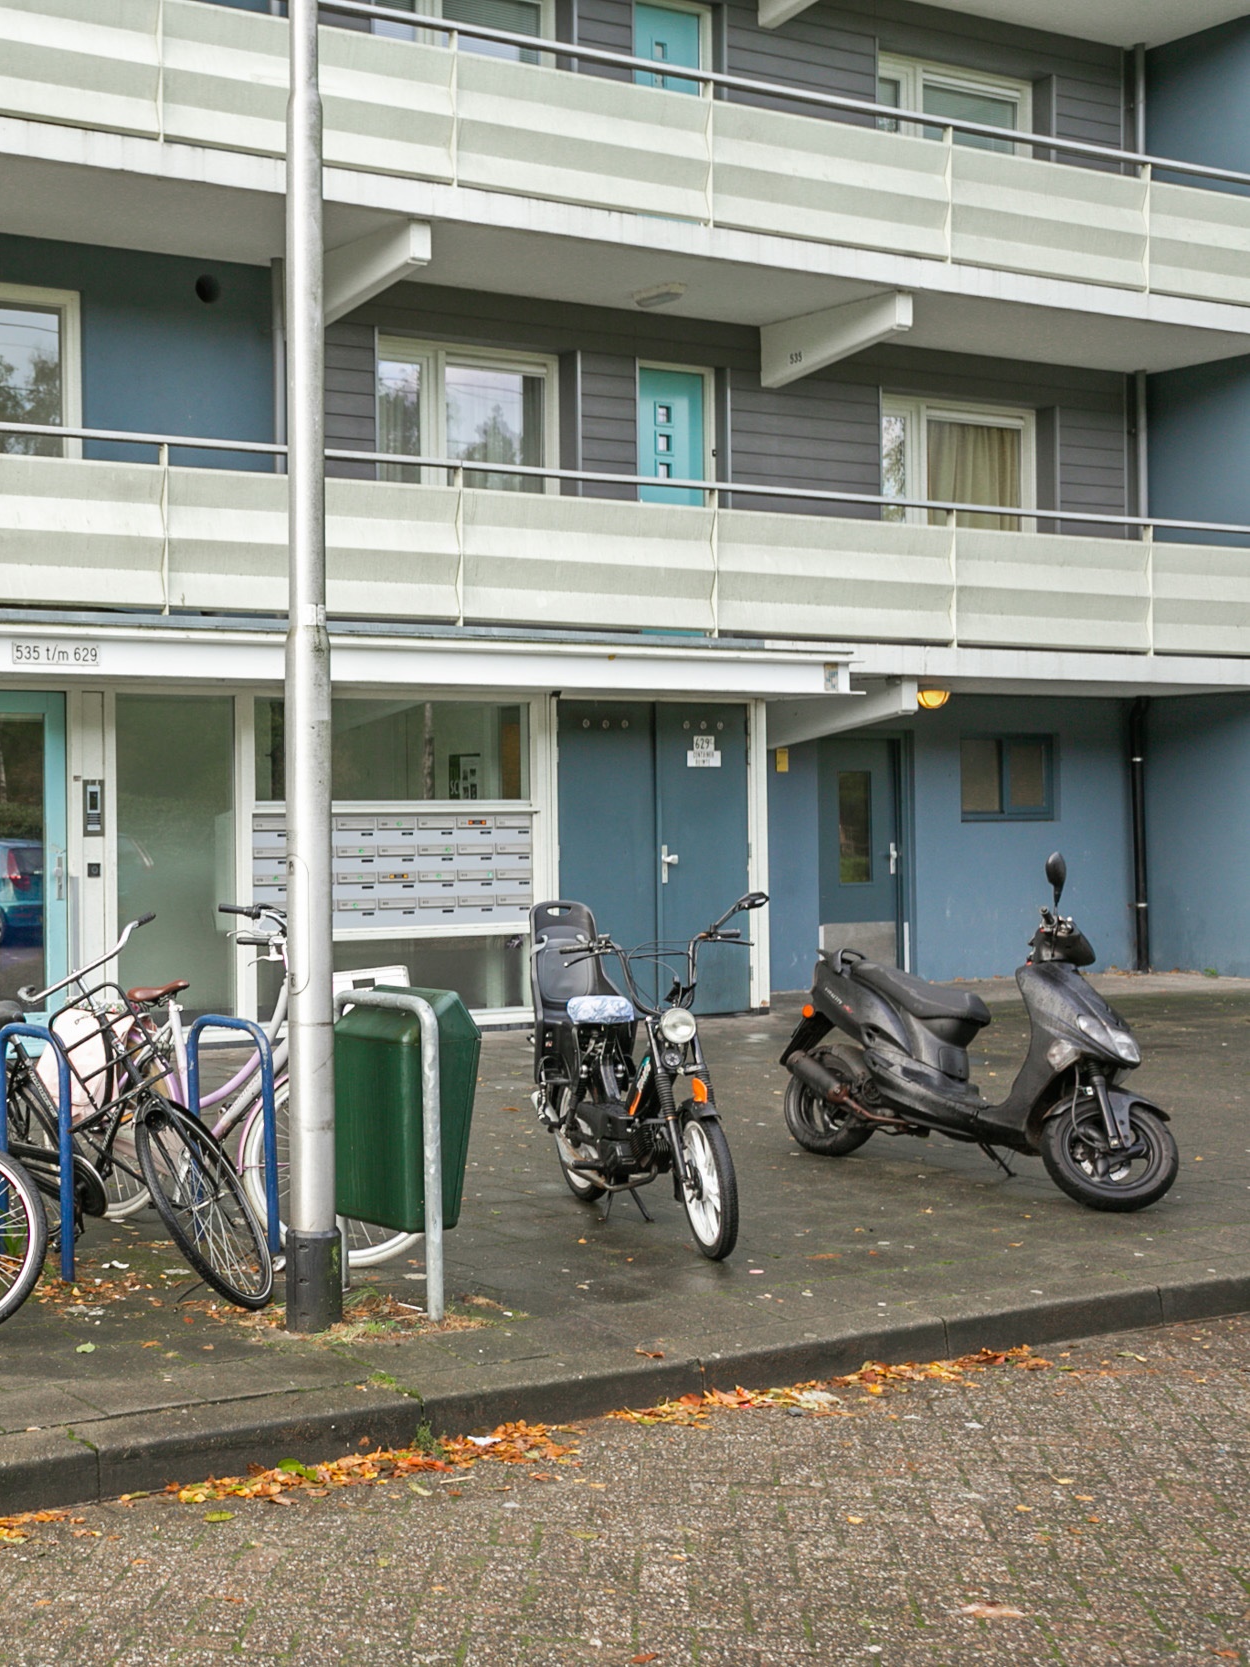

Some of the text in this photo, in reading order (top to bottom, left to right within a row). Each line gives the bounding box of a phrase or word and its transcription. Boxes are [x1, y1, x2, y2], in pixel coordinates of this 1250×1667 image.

[15, 644, 98, 663] 535 t/m 629
